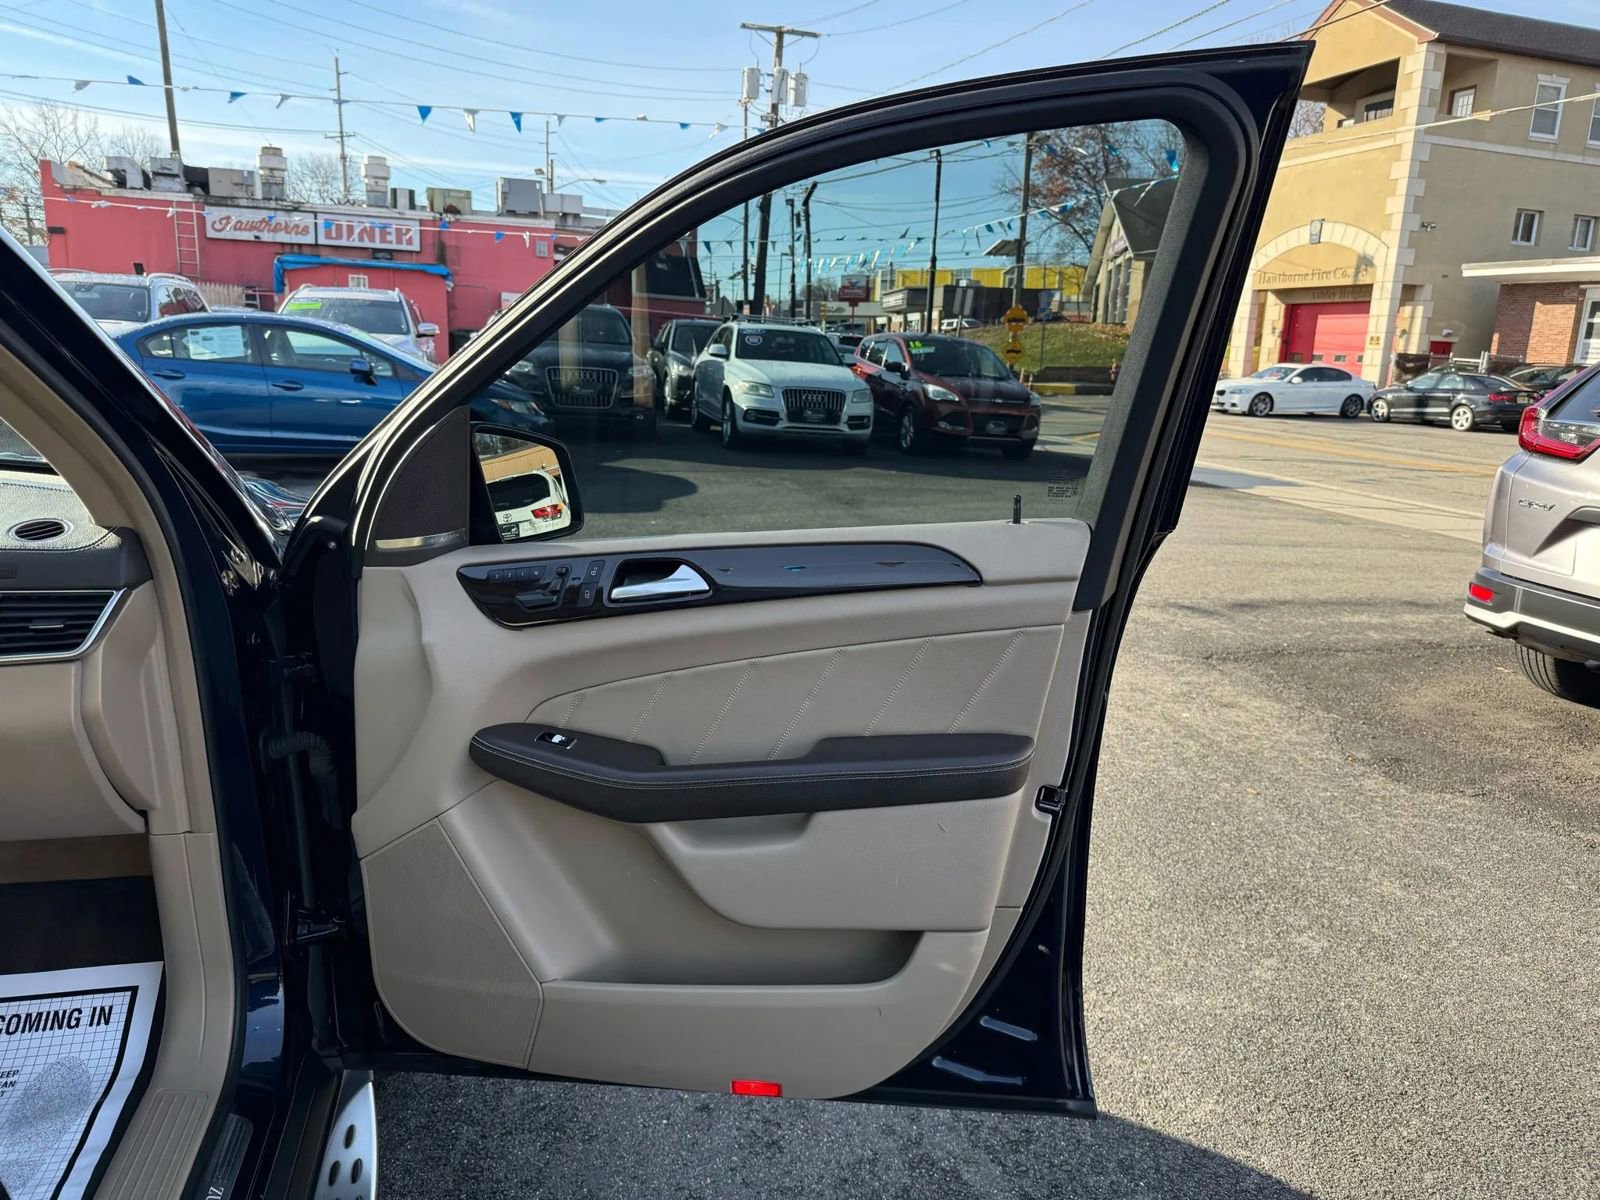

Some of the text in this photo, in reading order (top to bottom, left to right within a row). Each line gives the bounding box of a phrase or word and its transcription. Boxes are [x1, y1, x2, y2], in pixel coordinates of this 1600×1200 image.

[211, 214, 414, 246] Hawthorne DINER
[1258, 271, 1309, 285] Hawthorne
[1311, 268, 1331, 280] Fire
[1333, 267, 1350, 279] Co.
[89, 1005, 113, 1027] IN
[0, 1069, 19, 1079] EEP
